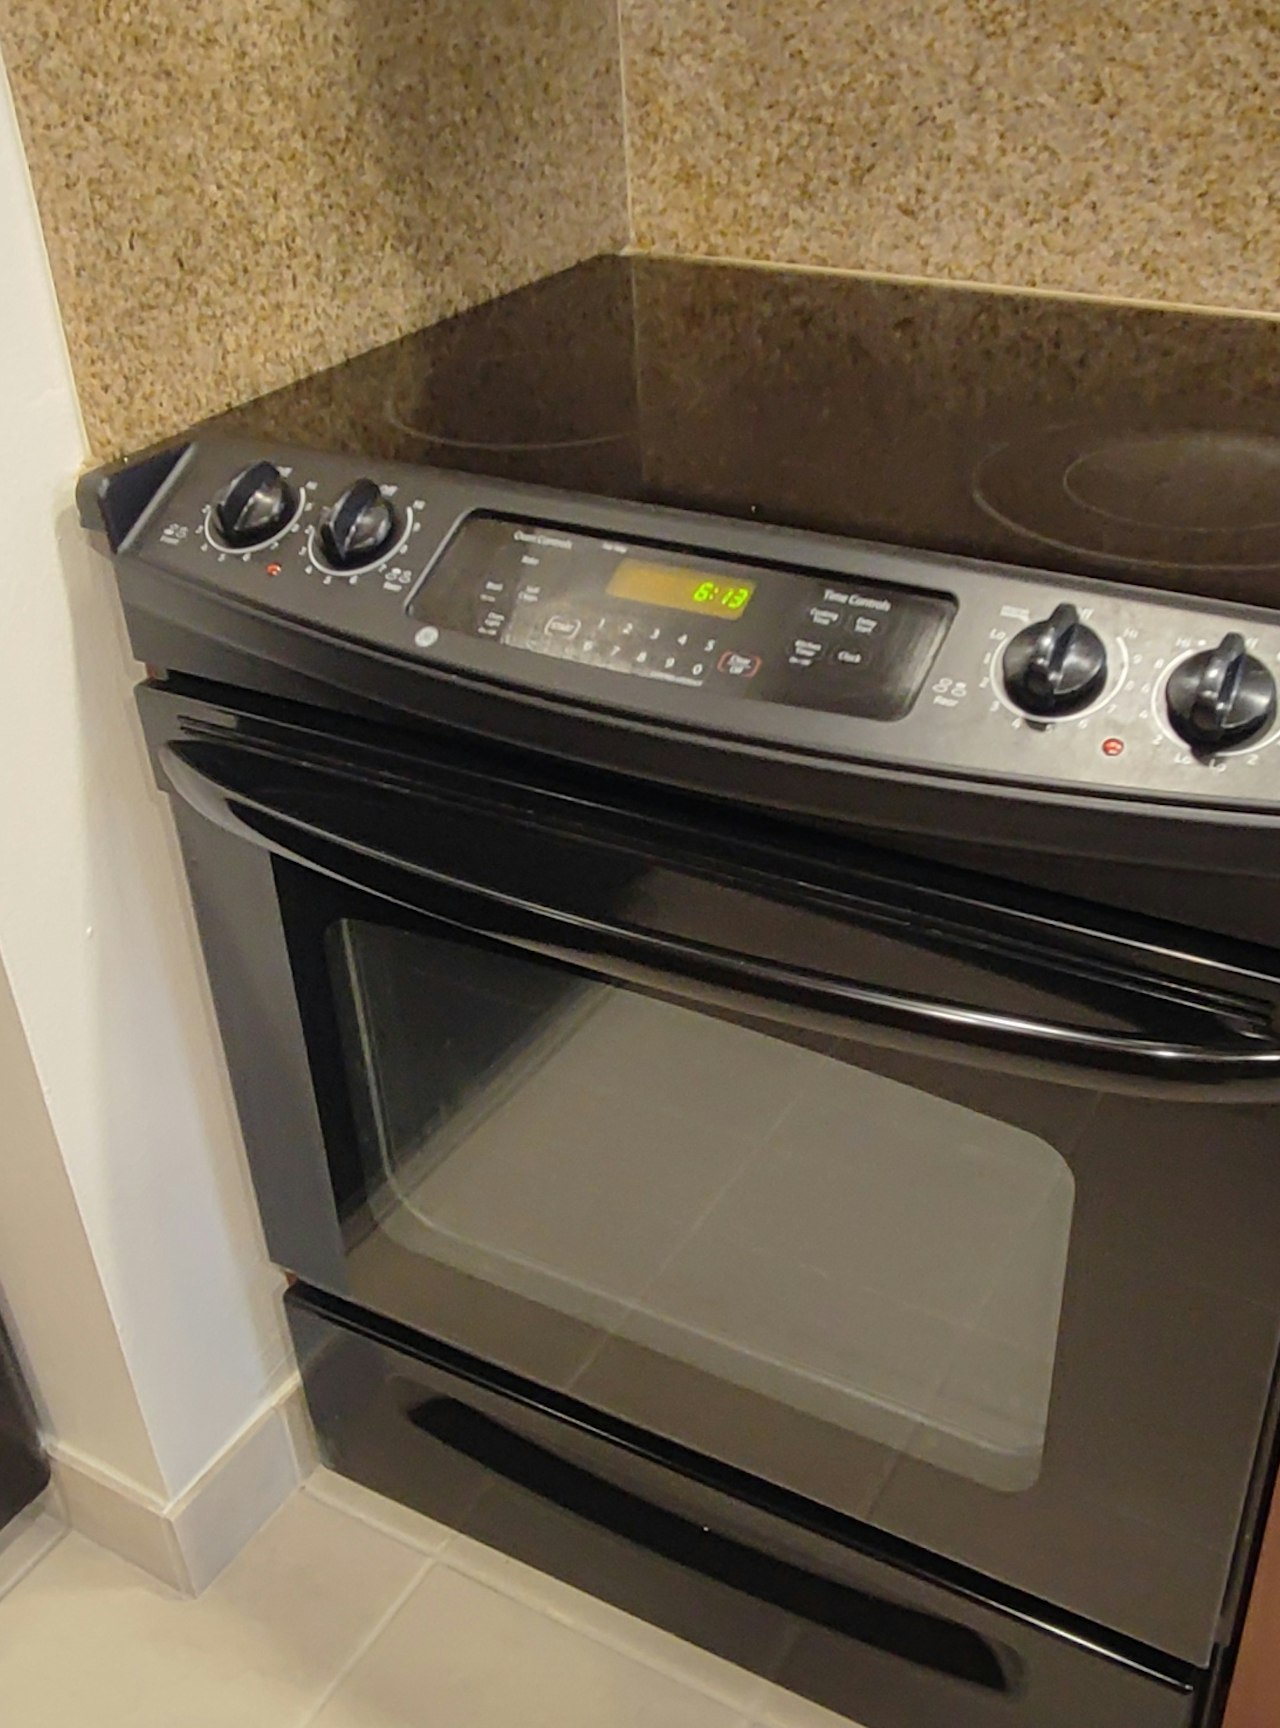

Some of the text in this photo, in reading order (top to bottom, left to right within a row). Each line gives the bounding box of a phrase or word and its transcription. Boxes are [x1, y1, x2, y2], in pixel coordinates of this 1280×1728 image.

[694, 581, 749, 610] 6:13
[823, 588, 892, 612] Time Controls
[622, 622, 634, 635] 2
[649, 628, 661, 640] 3
[677, 633, 689, 646] 4
[1246, 753, 1259, 766] 2
